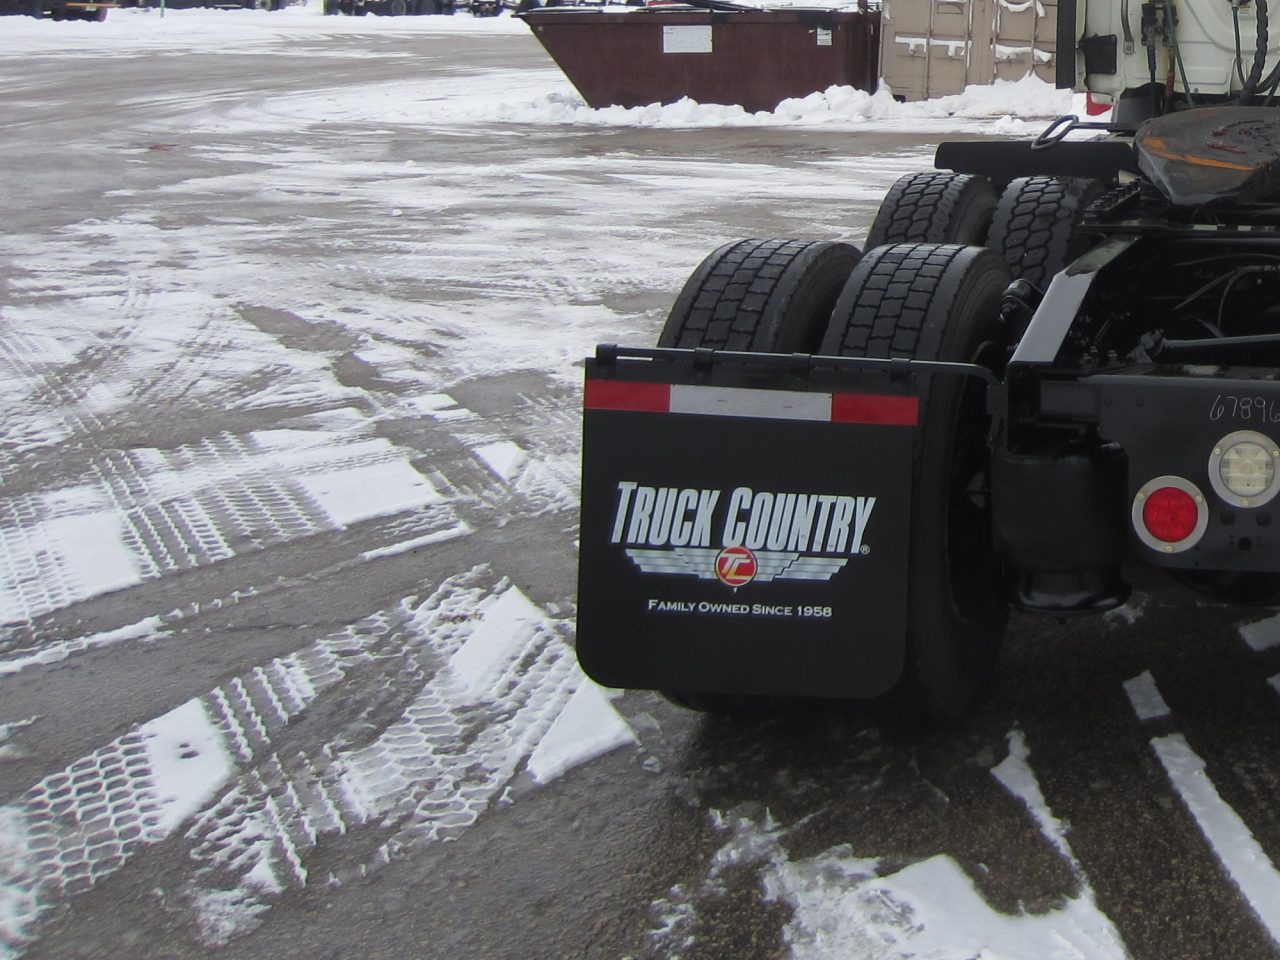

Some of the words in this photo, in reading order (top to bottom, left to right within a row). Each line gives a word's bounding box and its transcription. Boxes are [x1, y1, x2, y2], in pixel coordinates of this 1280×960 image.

[611, 481, 721, 547] TRUCK
[648, 599, 698, 612] FAMILY
[698, 601, 750, 615] OWNED
[751, 603, 793, 616] SINCE
[796, 605, 833, 617] 1958
